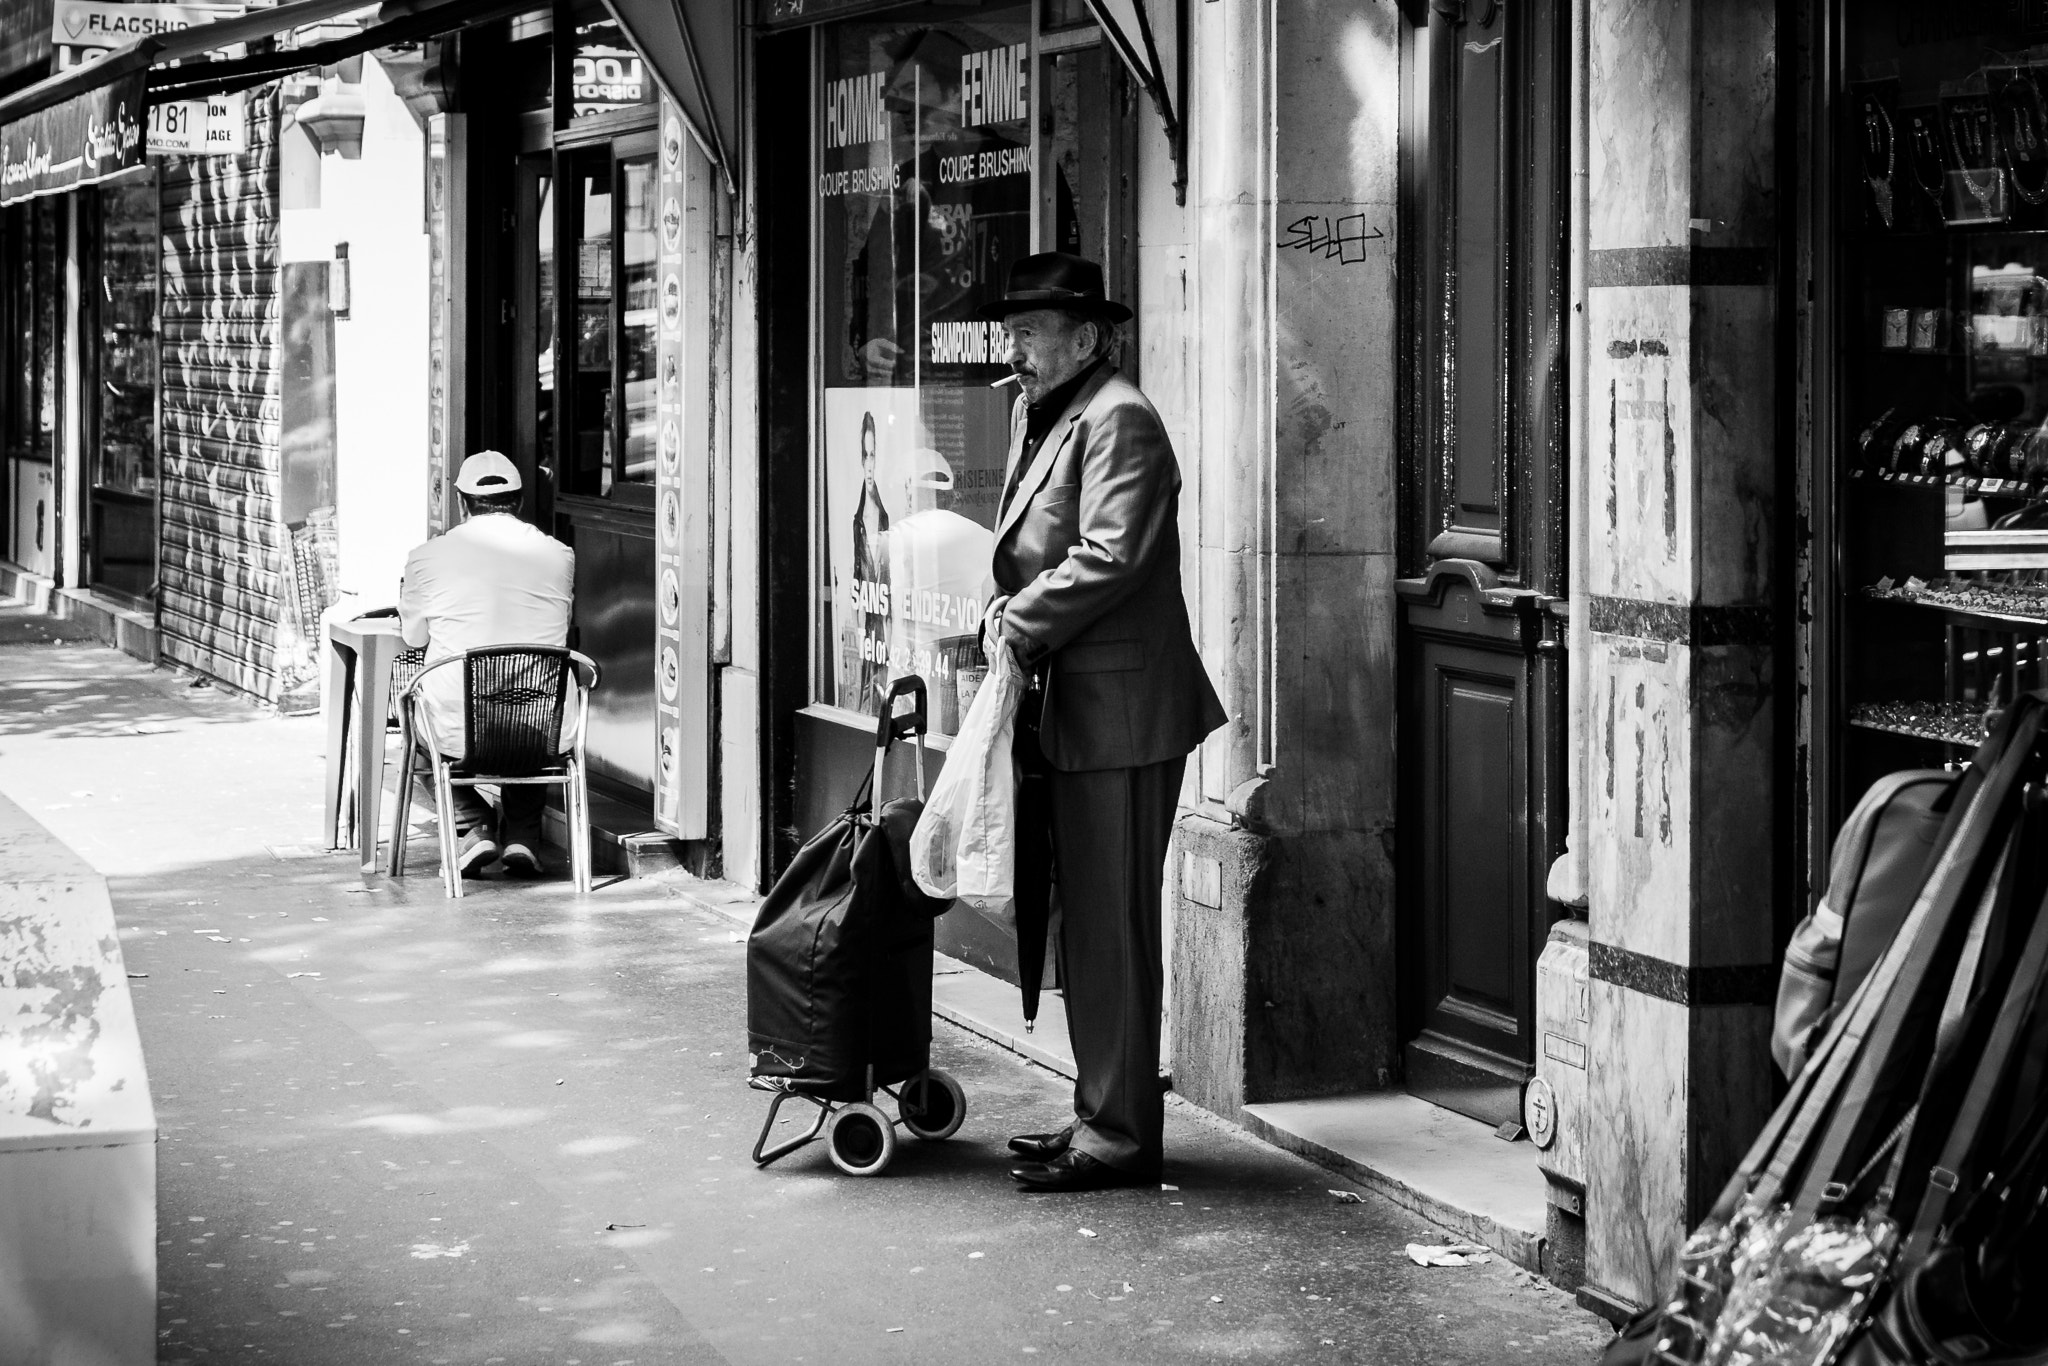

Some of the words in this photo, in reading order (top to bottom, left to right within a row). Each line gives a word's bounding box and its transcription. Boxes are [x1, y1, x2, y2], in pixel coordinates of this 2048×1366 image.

[961, 42, 1027, 128] FEMME
[827, 71, 885, 148] HOMME
[819, 171, 849, 197] COUPE
[852, 164, 901, 194] BRUSHING
[939, 153, 975, 184] COUPE
[931, 321, 988, 364] SHAMPOOING
[850, 578, 889, 616] SANS
